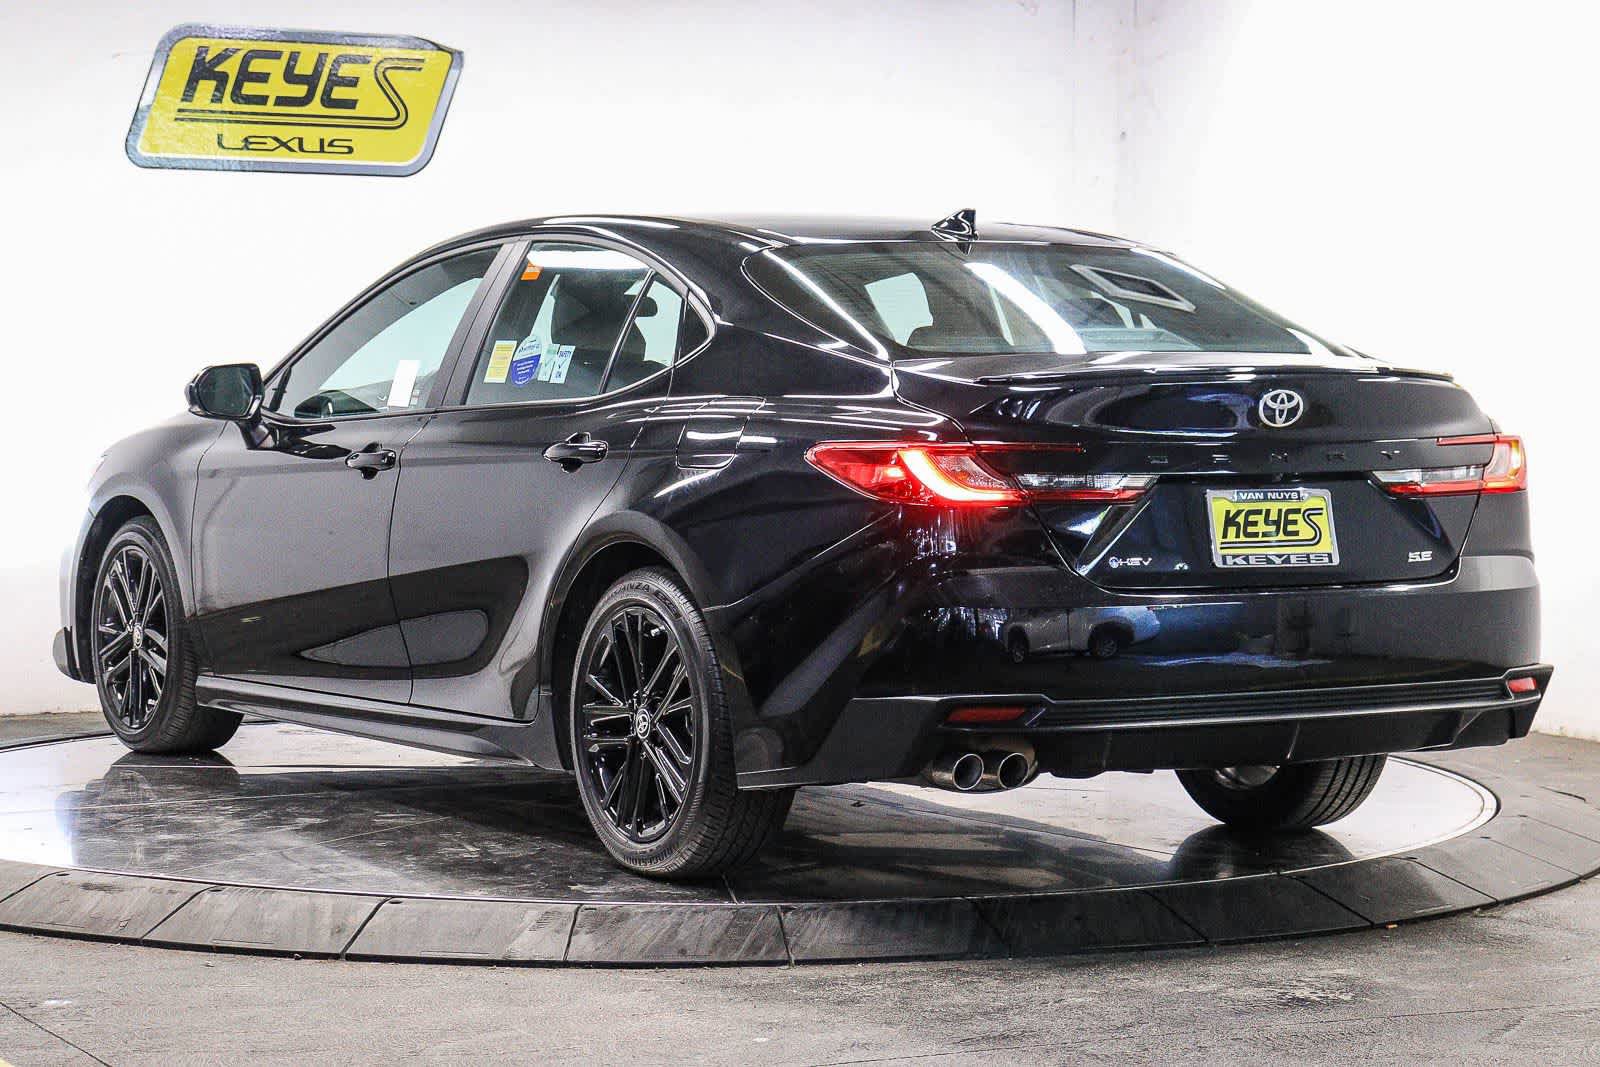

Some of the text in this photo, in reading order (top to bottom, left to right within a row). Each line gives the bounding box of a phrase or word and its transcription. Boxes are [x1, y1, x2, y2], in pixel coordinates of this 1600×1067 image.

[177, 46, 426, 128] KEYES
[216, 133, 354, 154] LEXUS
[1239, 491, 1299, 500] VAN NUYS
[1220, 508, 1323, 549] KEYES
[1118, 557, 1152, 566] HEV
[1225, 554, 1329, 565] KEYES
[1408, 551, 1433, 562] SE
